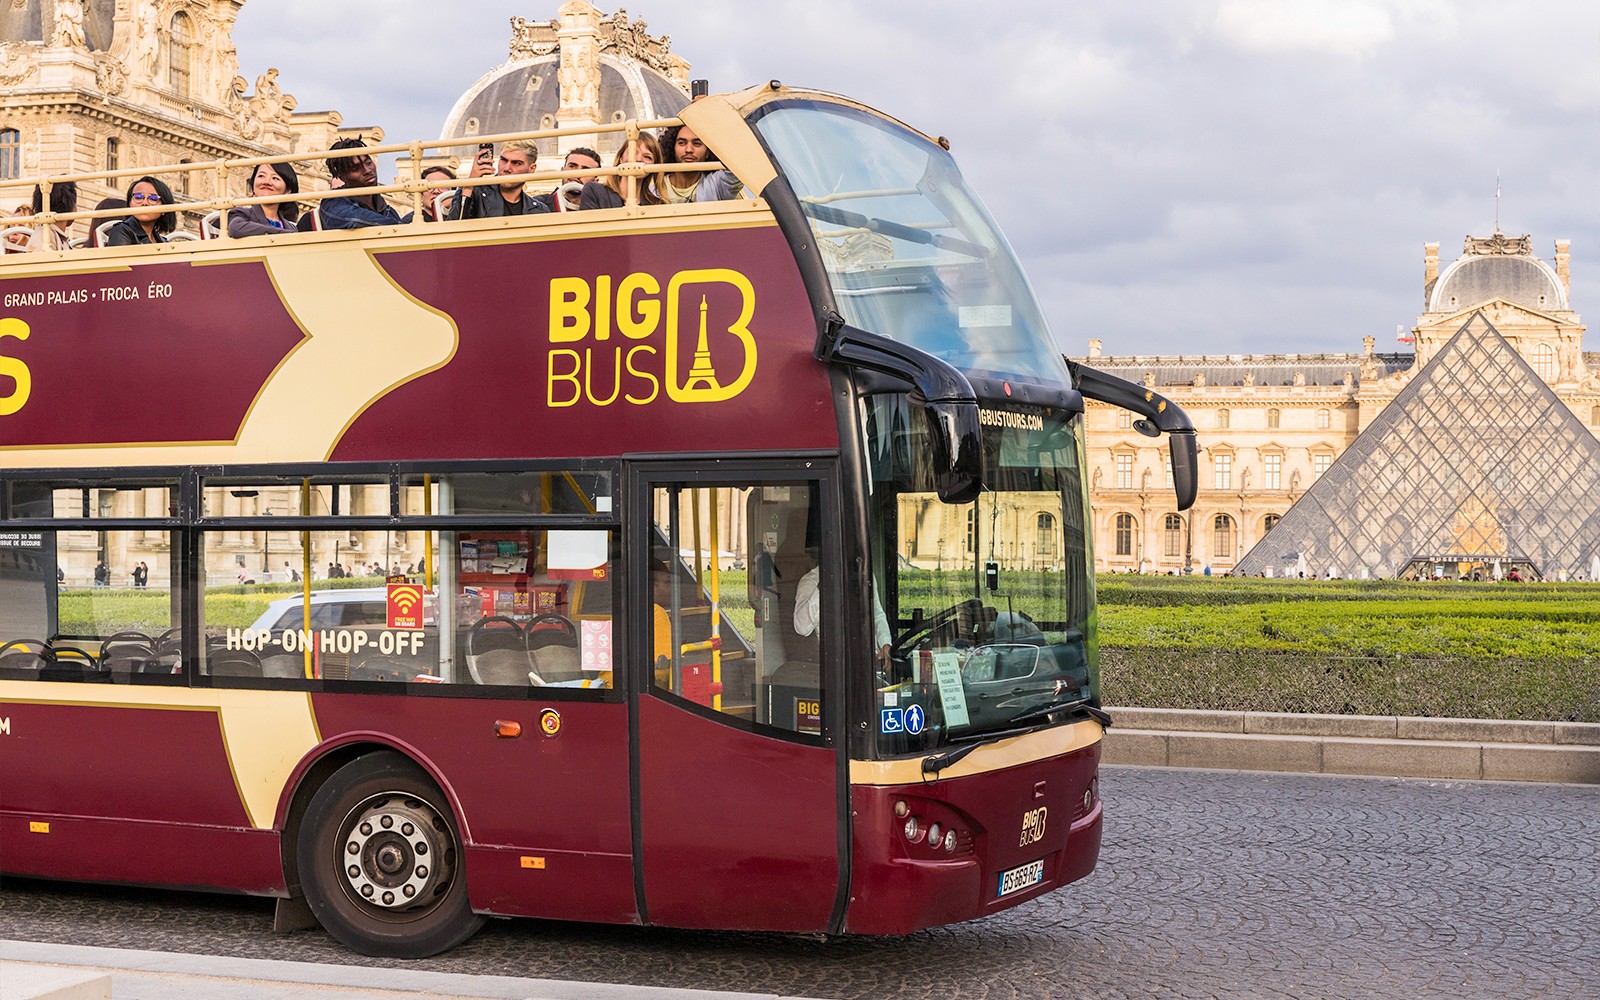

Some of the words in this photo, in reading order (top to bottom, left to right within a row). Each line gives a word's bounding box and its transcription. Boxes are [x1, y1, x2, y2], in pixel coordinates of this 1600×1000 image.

[4, 292, 44, 308] GRAND
[47, 289, 88, 304] PALAIS
[548, 272, 661, 343] BIG
[546, 345, 660, 407] BUS
[226, 628, 314, 652] HOP-ON
[320, 630, 426, 656] HOP-OFF
[799, 702, 819, 715] BIG
[1022, 809, 1038, 830] BIG
[1019, 827, 1035, 848] BUS
